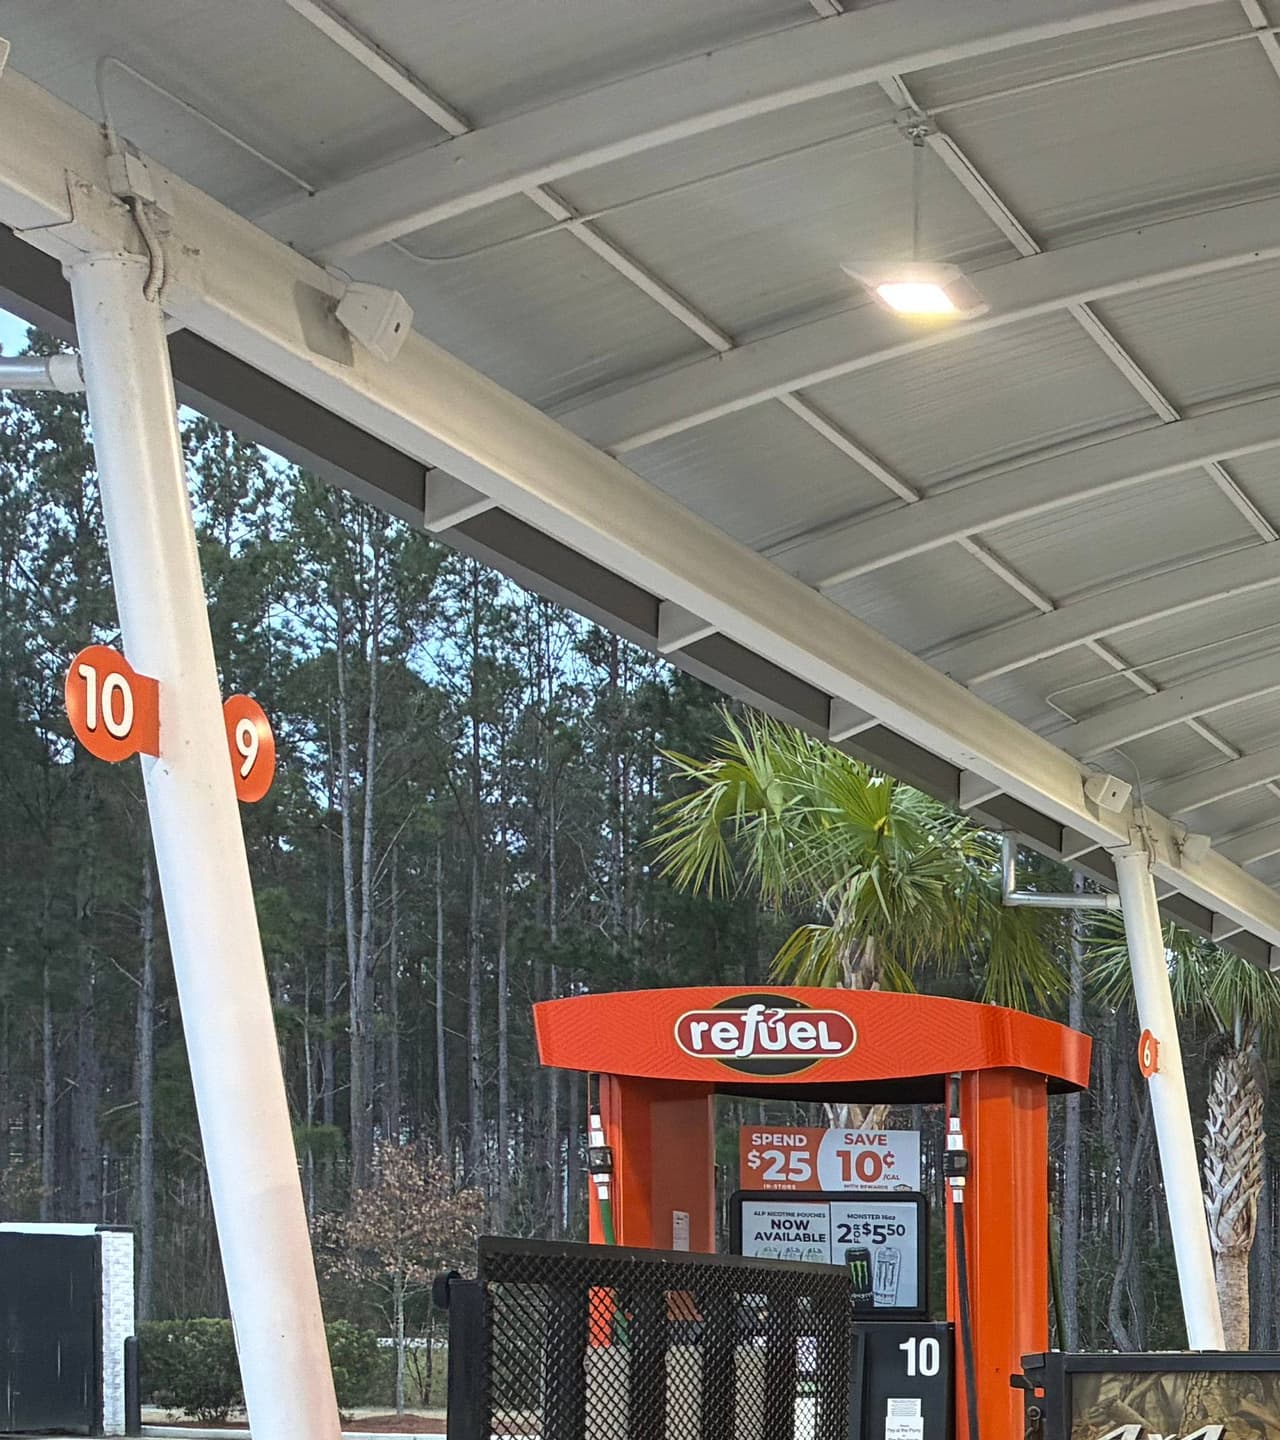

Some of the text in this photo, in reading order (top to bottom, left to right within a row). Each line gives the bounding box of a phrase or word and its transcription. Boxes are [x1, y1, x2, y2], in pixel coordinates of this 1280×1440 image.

[79, 664, 134, 737] 10
[236, 718, 259, 777] 9
[1144, 1040, 1151, 1067] 6
[752, 1133, 807, 1146] SPEND
[844, 1133, 887, 1146] SAVE
[747, 1149, 811, 1181] $25
[771, 1219, 810, 1230] NOW
[837, 1224, 852, 1243] 2
[754, 1232, 826, 1243] AVAILABLE
[899, 1337, 940, 1377] 10
